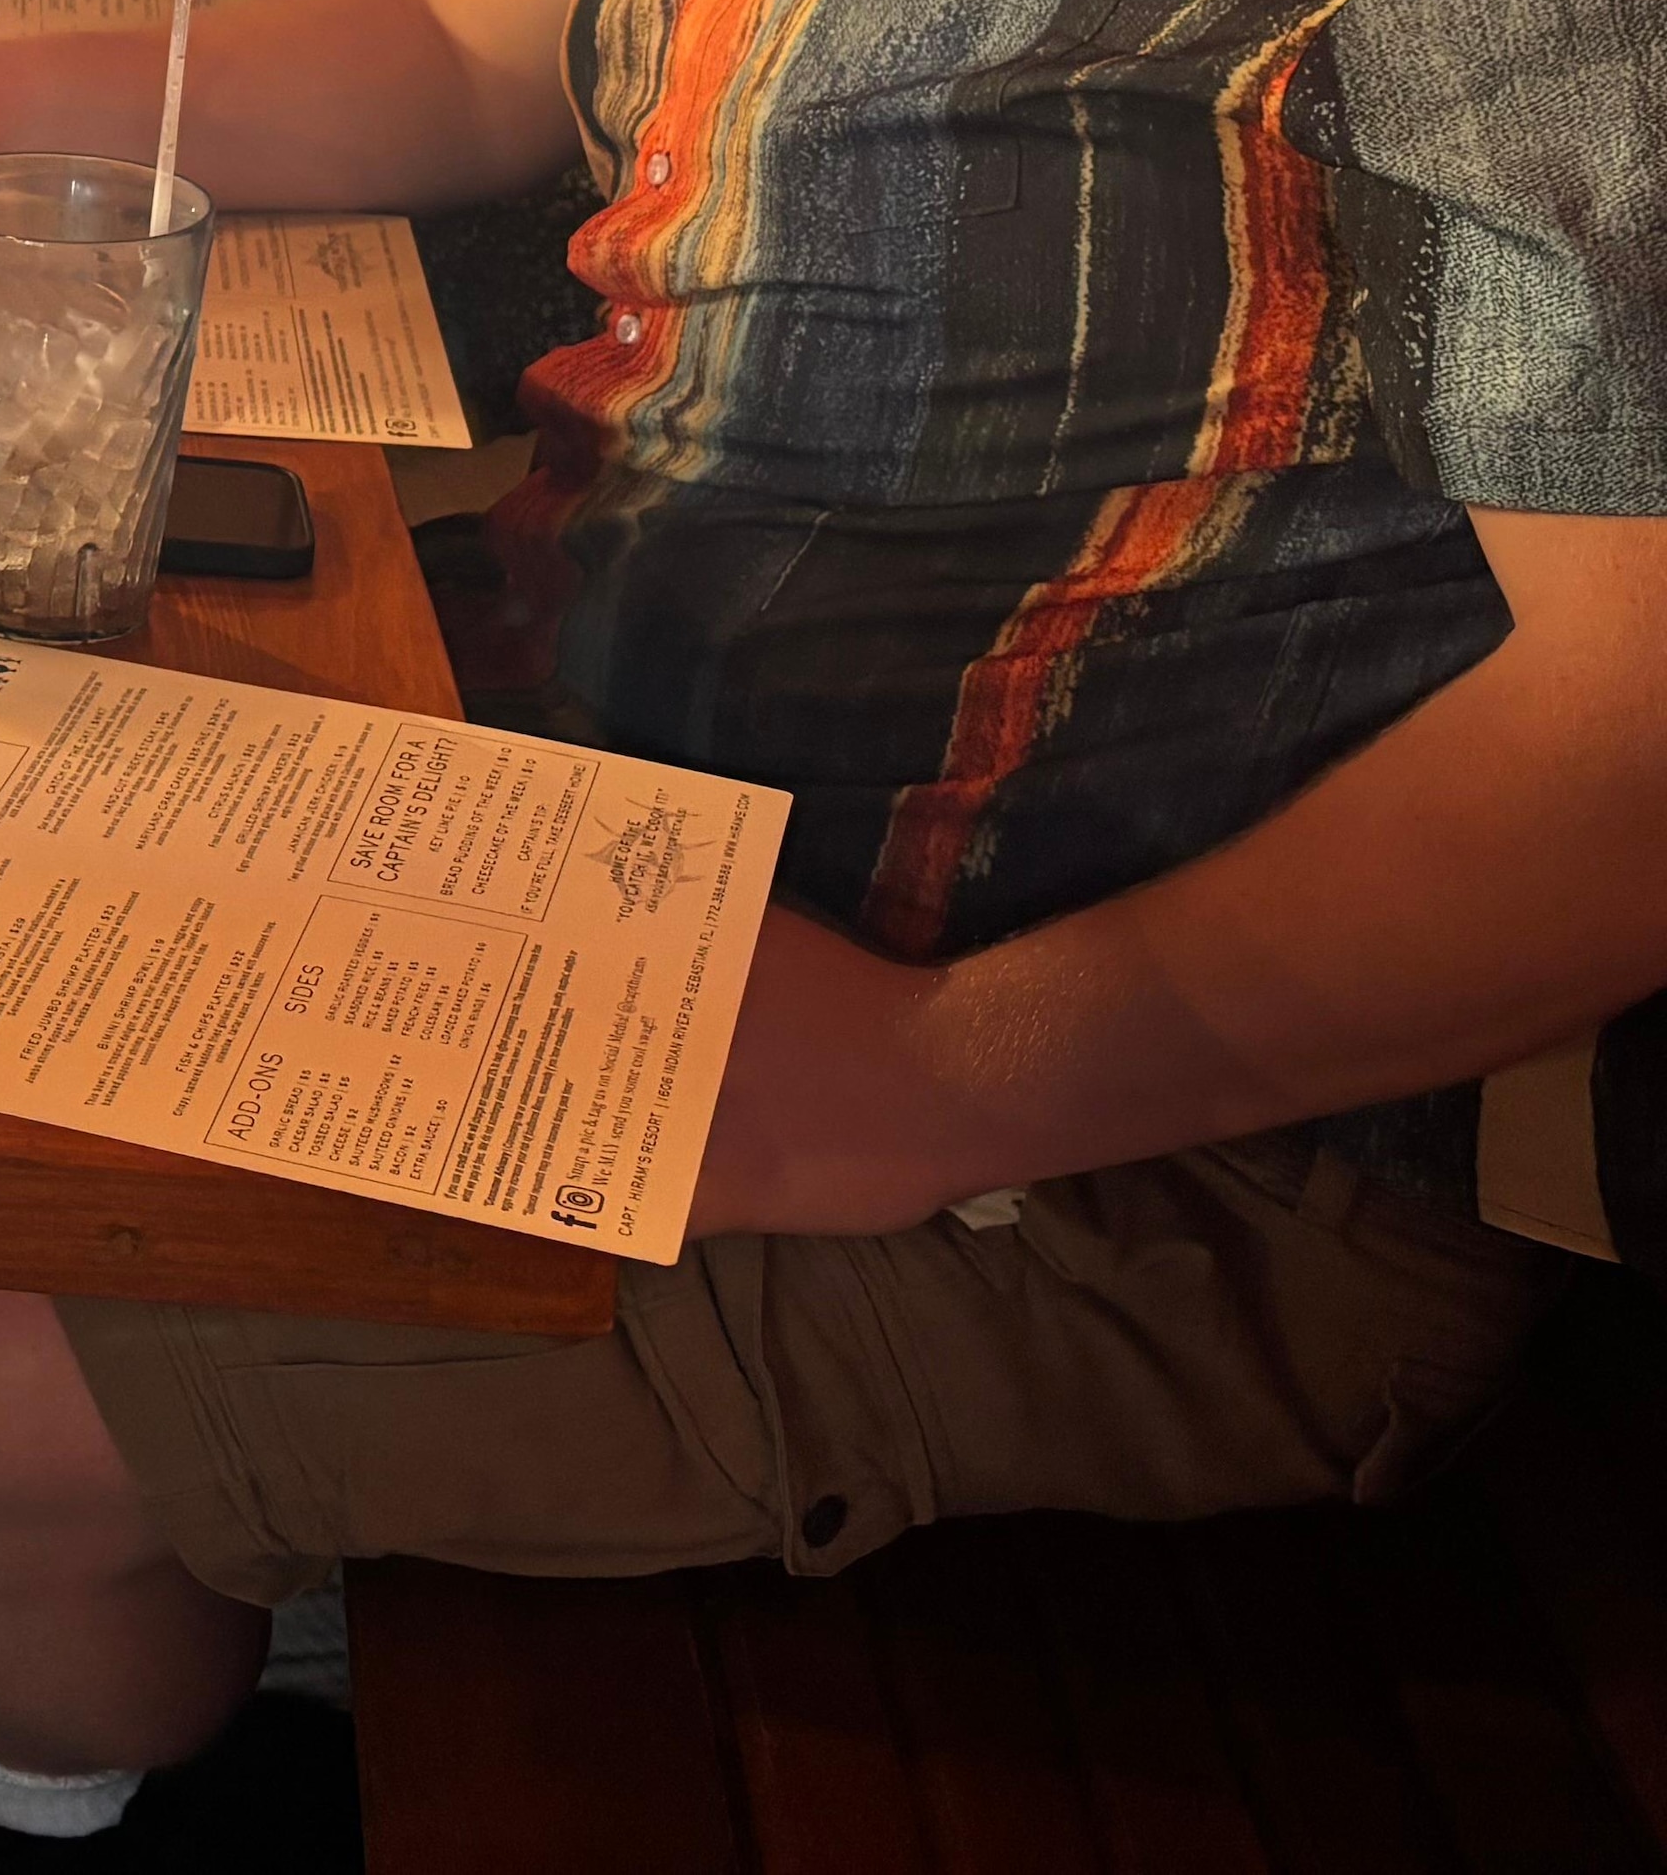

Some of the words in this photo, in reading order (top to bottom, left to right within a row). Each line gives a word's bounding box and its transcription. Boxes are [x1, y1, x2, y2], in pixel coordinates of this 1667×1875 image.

[483, 768, 503, 791] WEEK
[508, 779, 528, 802] WEEK
[349, 829, 385, 869] SAVE
[369, 783, 405, 826] ROOM
[390, 750, 420, 780] FOR
[406, 739, 426, 749] A
[375, 804, 428, 882] CAPTAIN'S
[412, 737, 458, 802] DELIGHT?
[444, 797, 461, 812] PIE
[475, 792, 493, 809] THE
[500, 803, 519, 821] THE
[553, 789, 577, 825] DESSERT
[435, 813, 454, 834] LIME
[469, 810, 485, 823] OF
[495, 823, 510, 835] OF
[645, 805, 665, 831] COOK
[426, 835, 445, 852] KEY
[452, 823, 480, 864] PUDDING
[516, 818, 543, 862] CAPTAIN'S
[545, 825, 563, 846] TAKE
[639, 830, 657, 847] WE
[471, 835, 506, 895] CHEESECAKE
[607, 854, 629, 883] HOME
[622, 819, 641, 838] THE
[439, 864, 463, 896] BREAD
[523, 871, 547, 904] YOU'RE
[623, 863, 647, 896] CATCH
[684, 942, 711, 994] SEBASTIAN,
[18, 1031, 44, 1060] FRIED
[35, 998, 63, 1030] JUMBO
[54, 963, 82, 997] SHRIMP
[74, 926, 103, 963] PLATTER
[283, 963, 325, 1014] SIDES
[96, 1019, 121, 1050] BIMINI
[113, 984, 140, 1019] SHRIMP
[131, 960, 153, 984] BOWL
[174, 1050, 195, 1073] FISH
[191, 1012, 214, 1040] CHIPS
[205, 973, 234, 1011] PLATTER
[608, 1012, 631, 1043] Media!
[671, 1011, 692, 1040] RIVER
[598, 1043, 621, 1073] Social
[626, 1042, 648, 1071] cool
[662, 1040, 684, 1075] INDIAN
[591, 1087, 608, 1101] us
[595, 1073, 613, 1088] on
[619, 1068, 641, 1094] some
[655, 1075, 675, 1101] 1606
[225, 1051, 284, 1141] ADD-ONS
[585, 1100, 607, 1121] tag
[613, 1094, 633, 1115] you
[268, 1116, 291, 1148] GARLIC
[282, 1086, 304, 1115] BREAD
[348, 1125, 374, 1166] SAUTEED
[364, 1071, 395, 1125] MUSHROOMS
[606, 1114, 627, 1140] send
[577, 1127, 599, 1146] pic
[639, 1112, 665, 1154] RESORT
[566, 1154, 588, 1182] Snap
[597, 1141, 620, 1167] MAY
[591, 1163, 614, 1188] We
[627, 1154, 653, 1201] HIRAM'S
[617, 1203, 640, 1237] CAPT.
